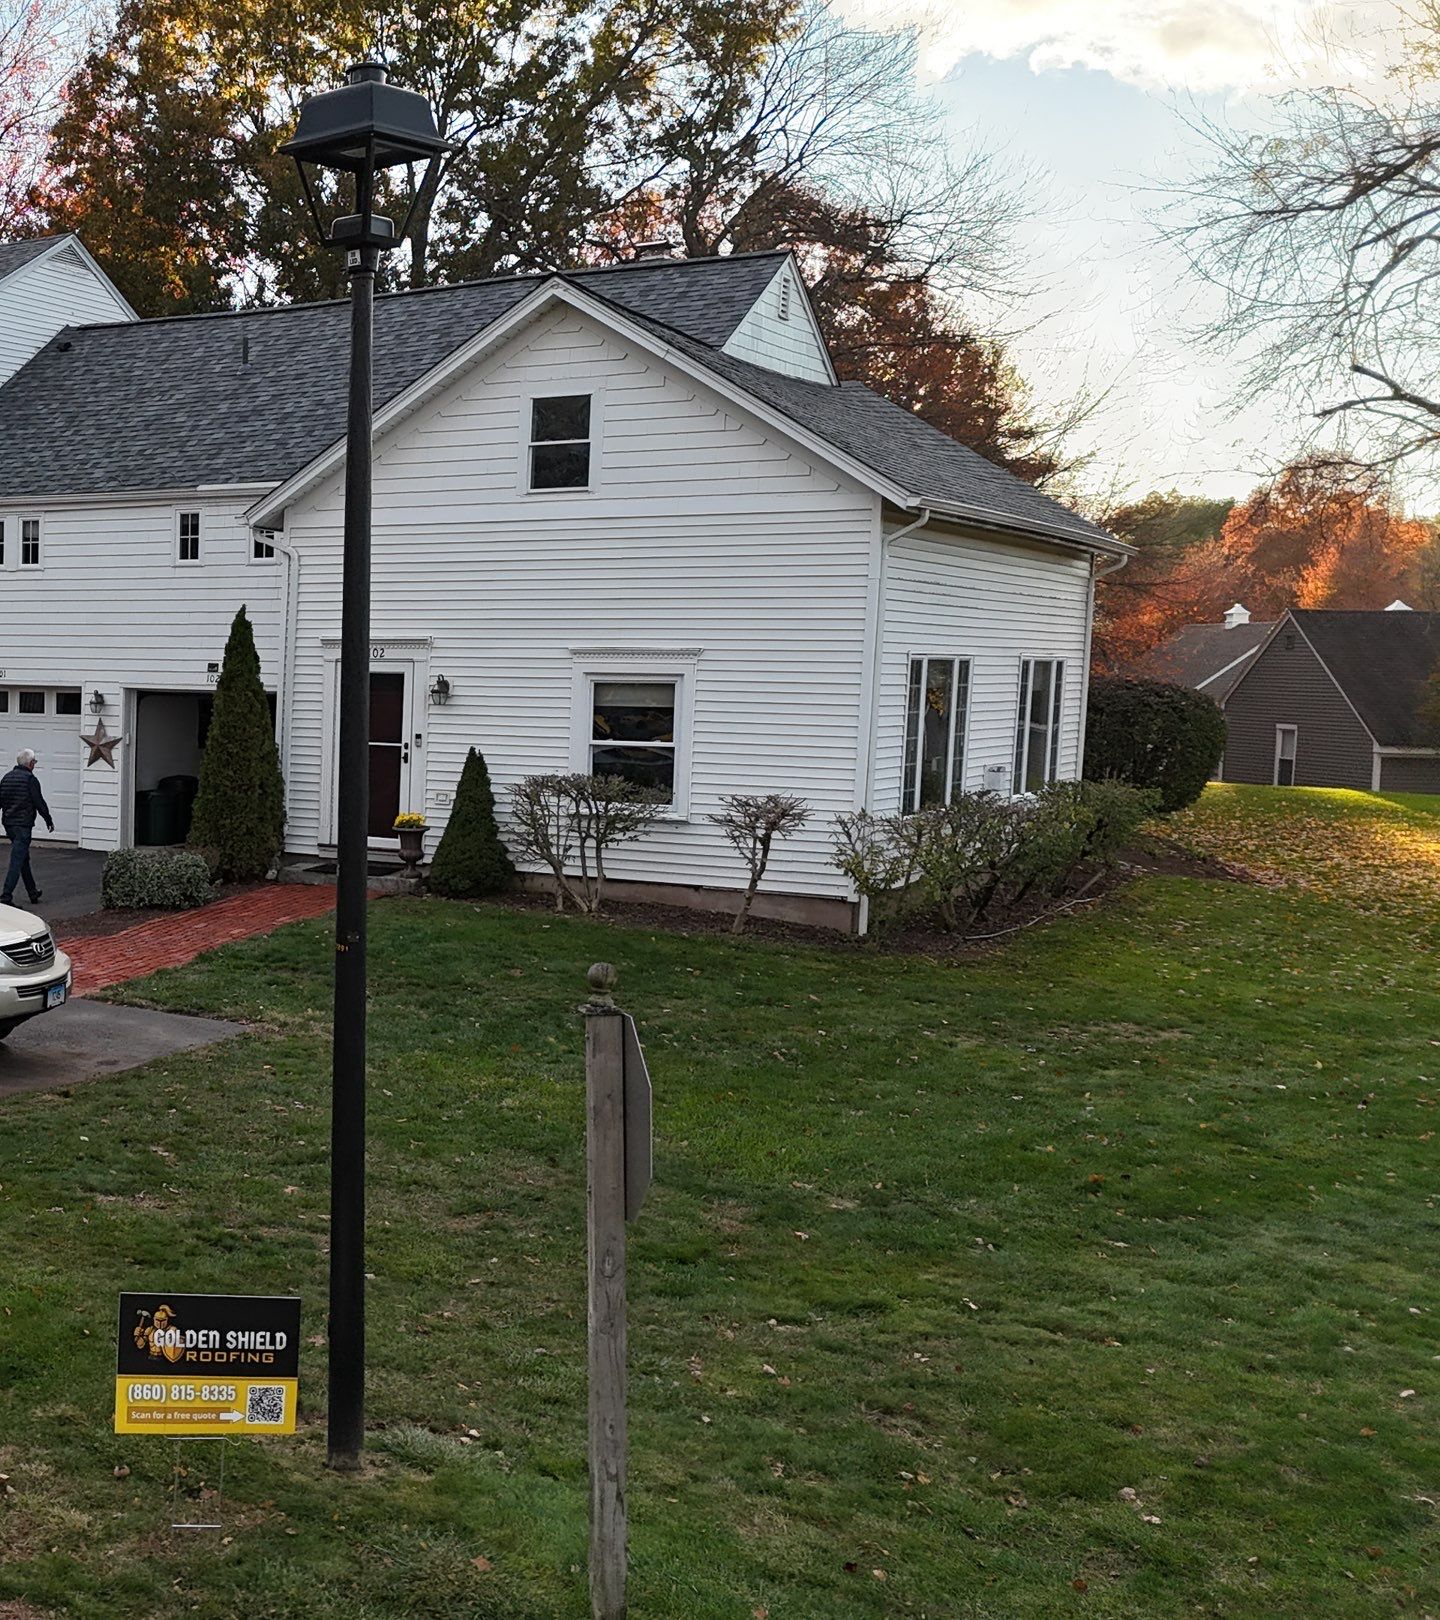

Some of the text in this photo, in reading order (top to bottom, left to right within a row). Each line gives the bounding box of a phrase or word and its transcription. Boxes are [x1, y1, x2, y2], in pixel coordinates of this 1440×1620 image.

[372, 648, 385, 658] 02
[153, 1328, 287, 1350] GOLDEN SHIELD
[185, 1351, 275, 1363] ROOFING
[128, 1384, 237, 1403] (860) 815-8335
[131, 1411, 151, 1419] Scan
[152, 1411, 165, 1419] for
[173, 1411, 191, 1419] free
[192, 1412, 217, 1421] quote
